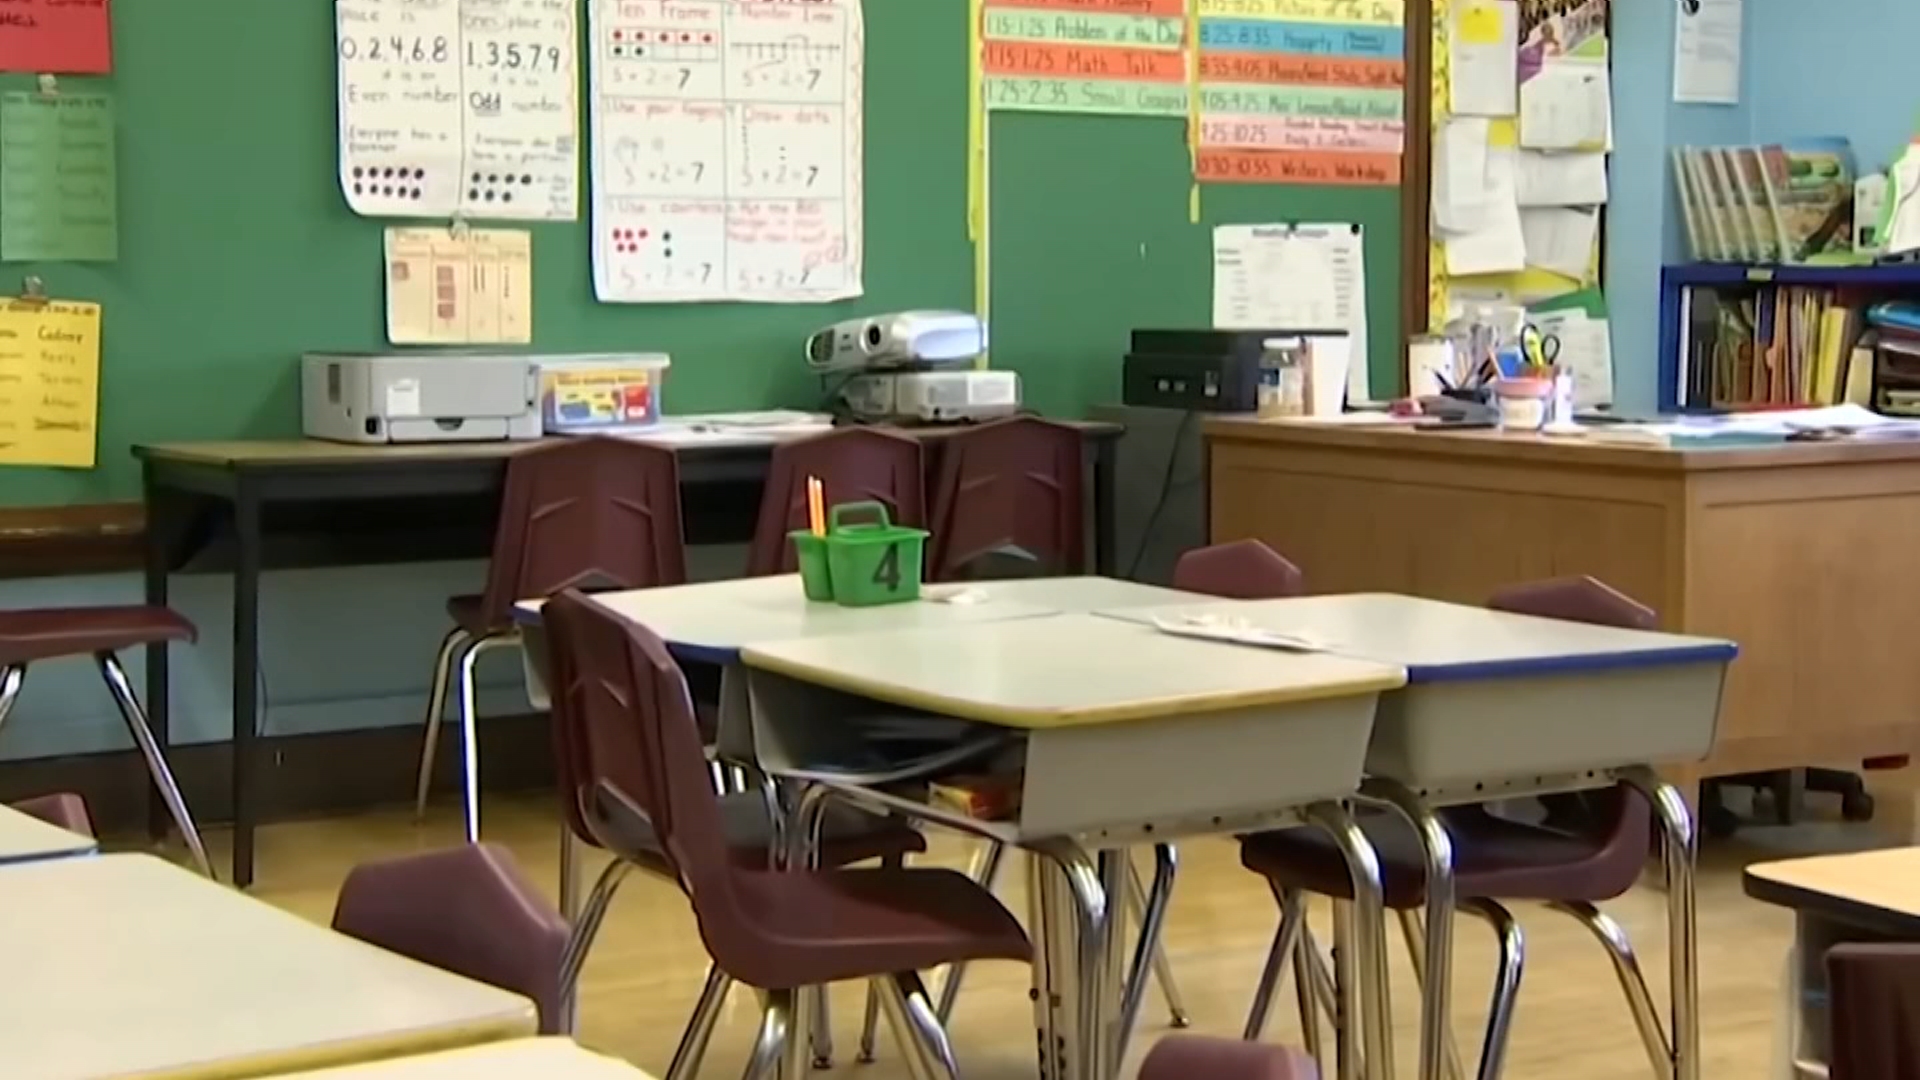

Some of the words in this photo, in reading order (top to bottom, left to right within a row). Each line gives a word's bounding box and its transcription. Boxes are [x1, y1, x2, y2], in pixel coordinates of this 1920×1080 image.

[1066, 51, 1109, 74] Math
[1124, 52, 1157, 76] Talk
[678, 68, 692, 90] 7
[807, 68, 822, 91] 7
[469, 92, 502, 111] Odd
[690, 161, 705, 184] 7
[805, 165, 820, 188] 7
[700, 262, 713, 284] 7
[873, 542, 900, 592] 4
